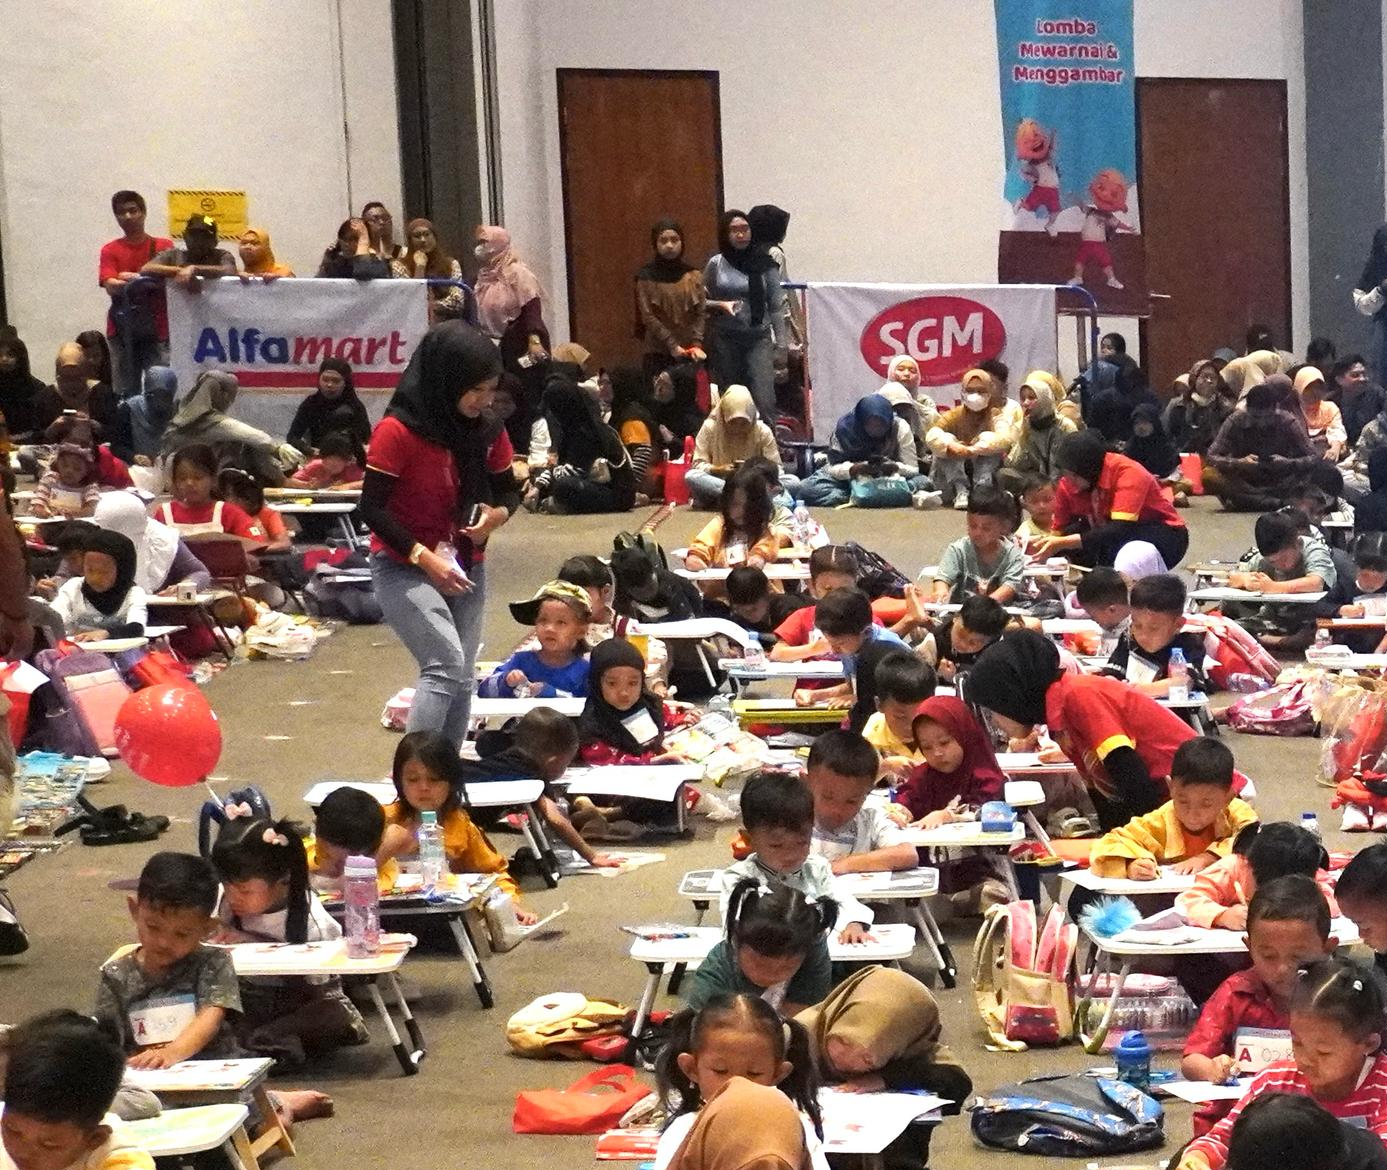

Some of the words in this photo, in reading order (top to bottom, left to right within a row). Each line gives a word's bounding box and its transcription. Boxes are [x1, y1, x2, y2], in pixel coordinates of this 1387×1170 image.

[1036, 18, 1097, 35] Lomba
[1019, 42, 1104, 59] Mewarnai
[1106, 43, 1119, 59] &
[1013, 66, 1123, 84] Menggambar
[193, 327, 407, 366] Alfamart
[879, 311, 984, 365] SGM
[1238, 1047, 1252, 1062] A
